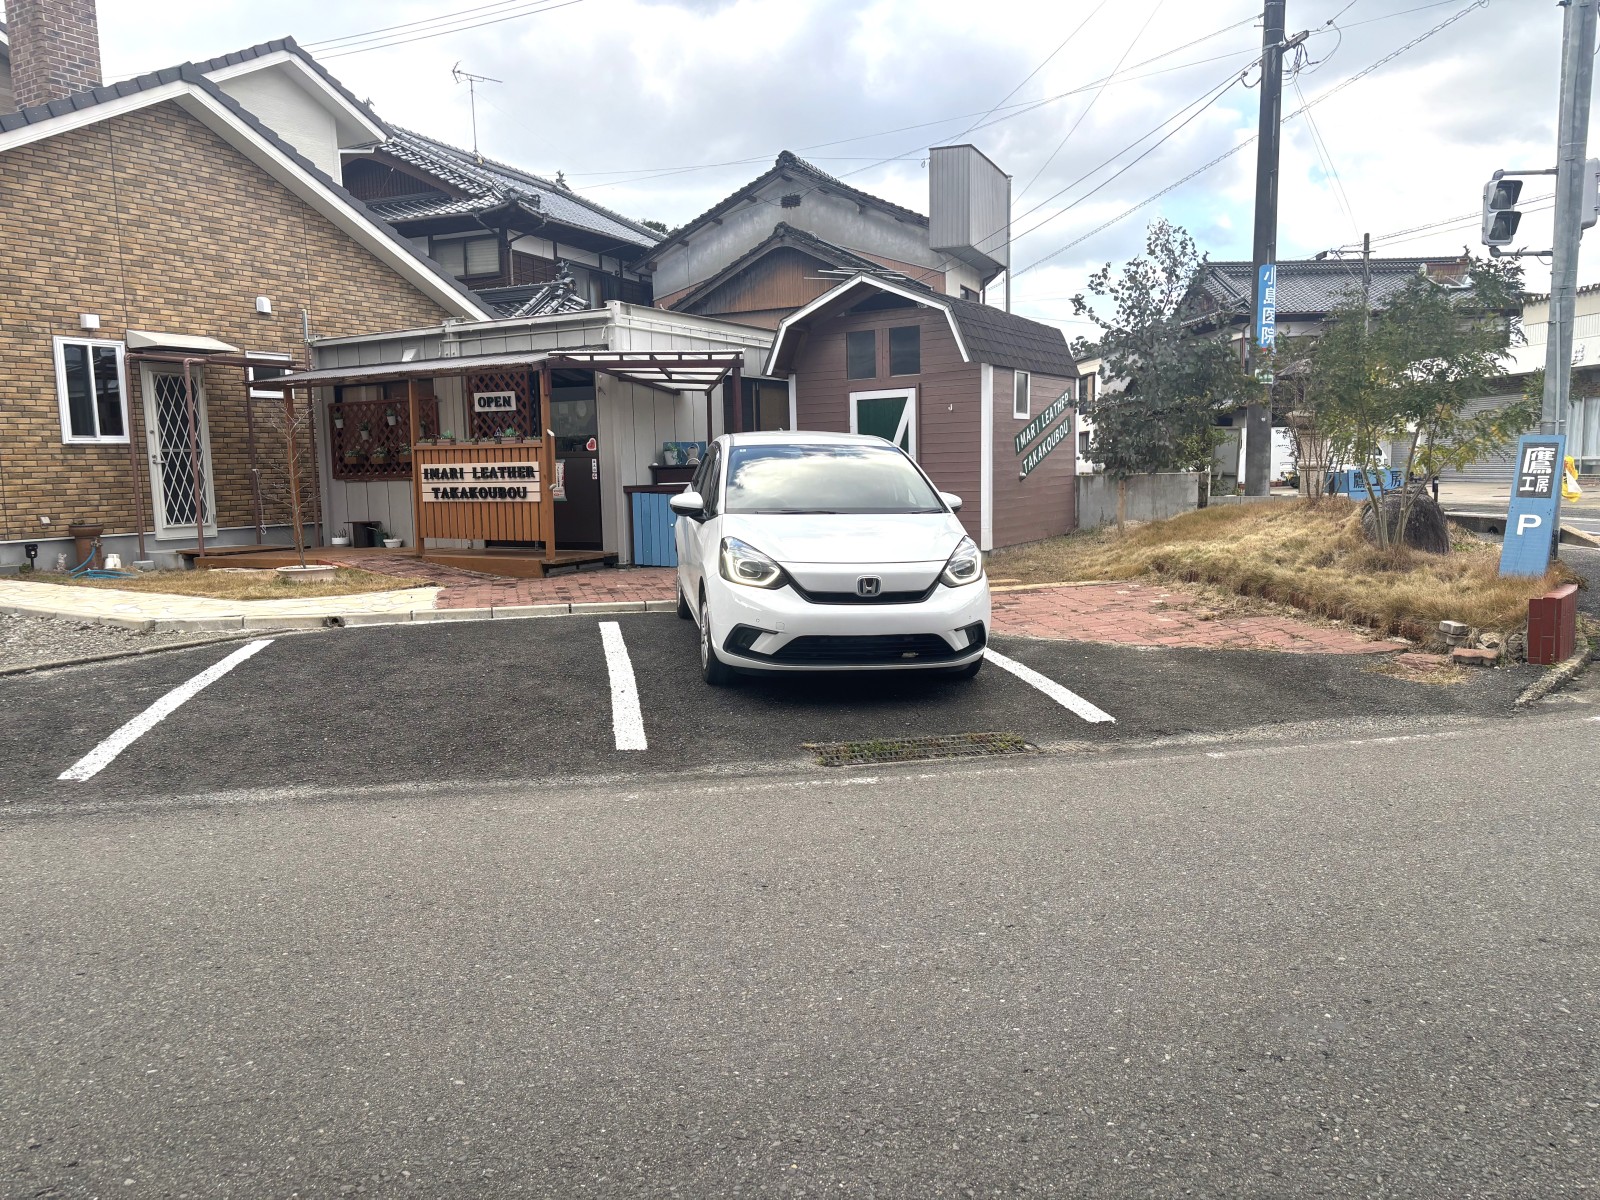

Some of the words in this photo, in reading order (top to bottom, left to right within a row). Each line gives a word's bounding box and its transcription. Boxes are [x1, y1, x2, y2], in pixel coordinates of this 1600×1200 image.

[1261, 267, 1276, 344] 小島医院
[477, 396, 512, 408] OPEN
[1016, 419, 1040, 452] IMARI
[1022, 420, 1069, 474] TAKAKOUBOU
[1522, 446, 1556, 474] 鷹
[423, 467, 464, 480] IMARI
[472, 466, 535, 479] LEATHER
[1519, 475, 1550, 493] 工房
[431, 487, 528, 499] TAKAKOUBOU
[1516, 514, 1542, 536] P
